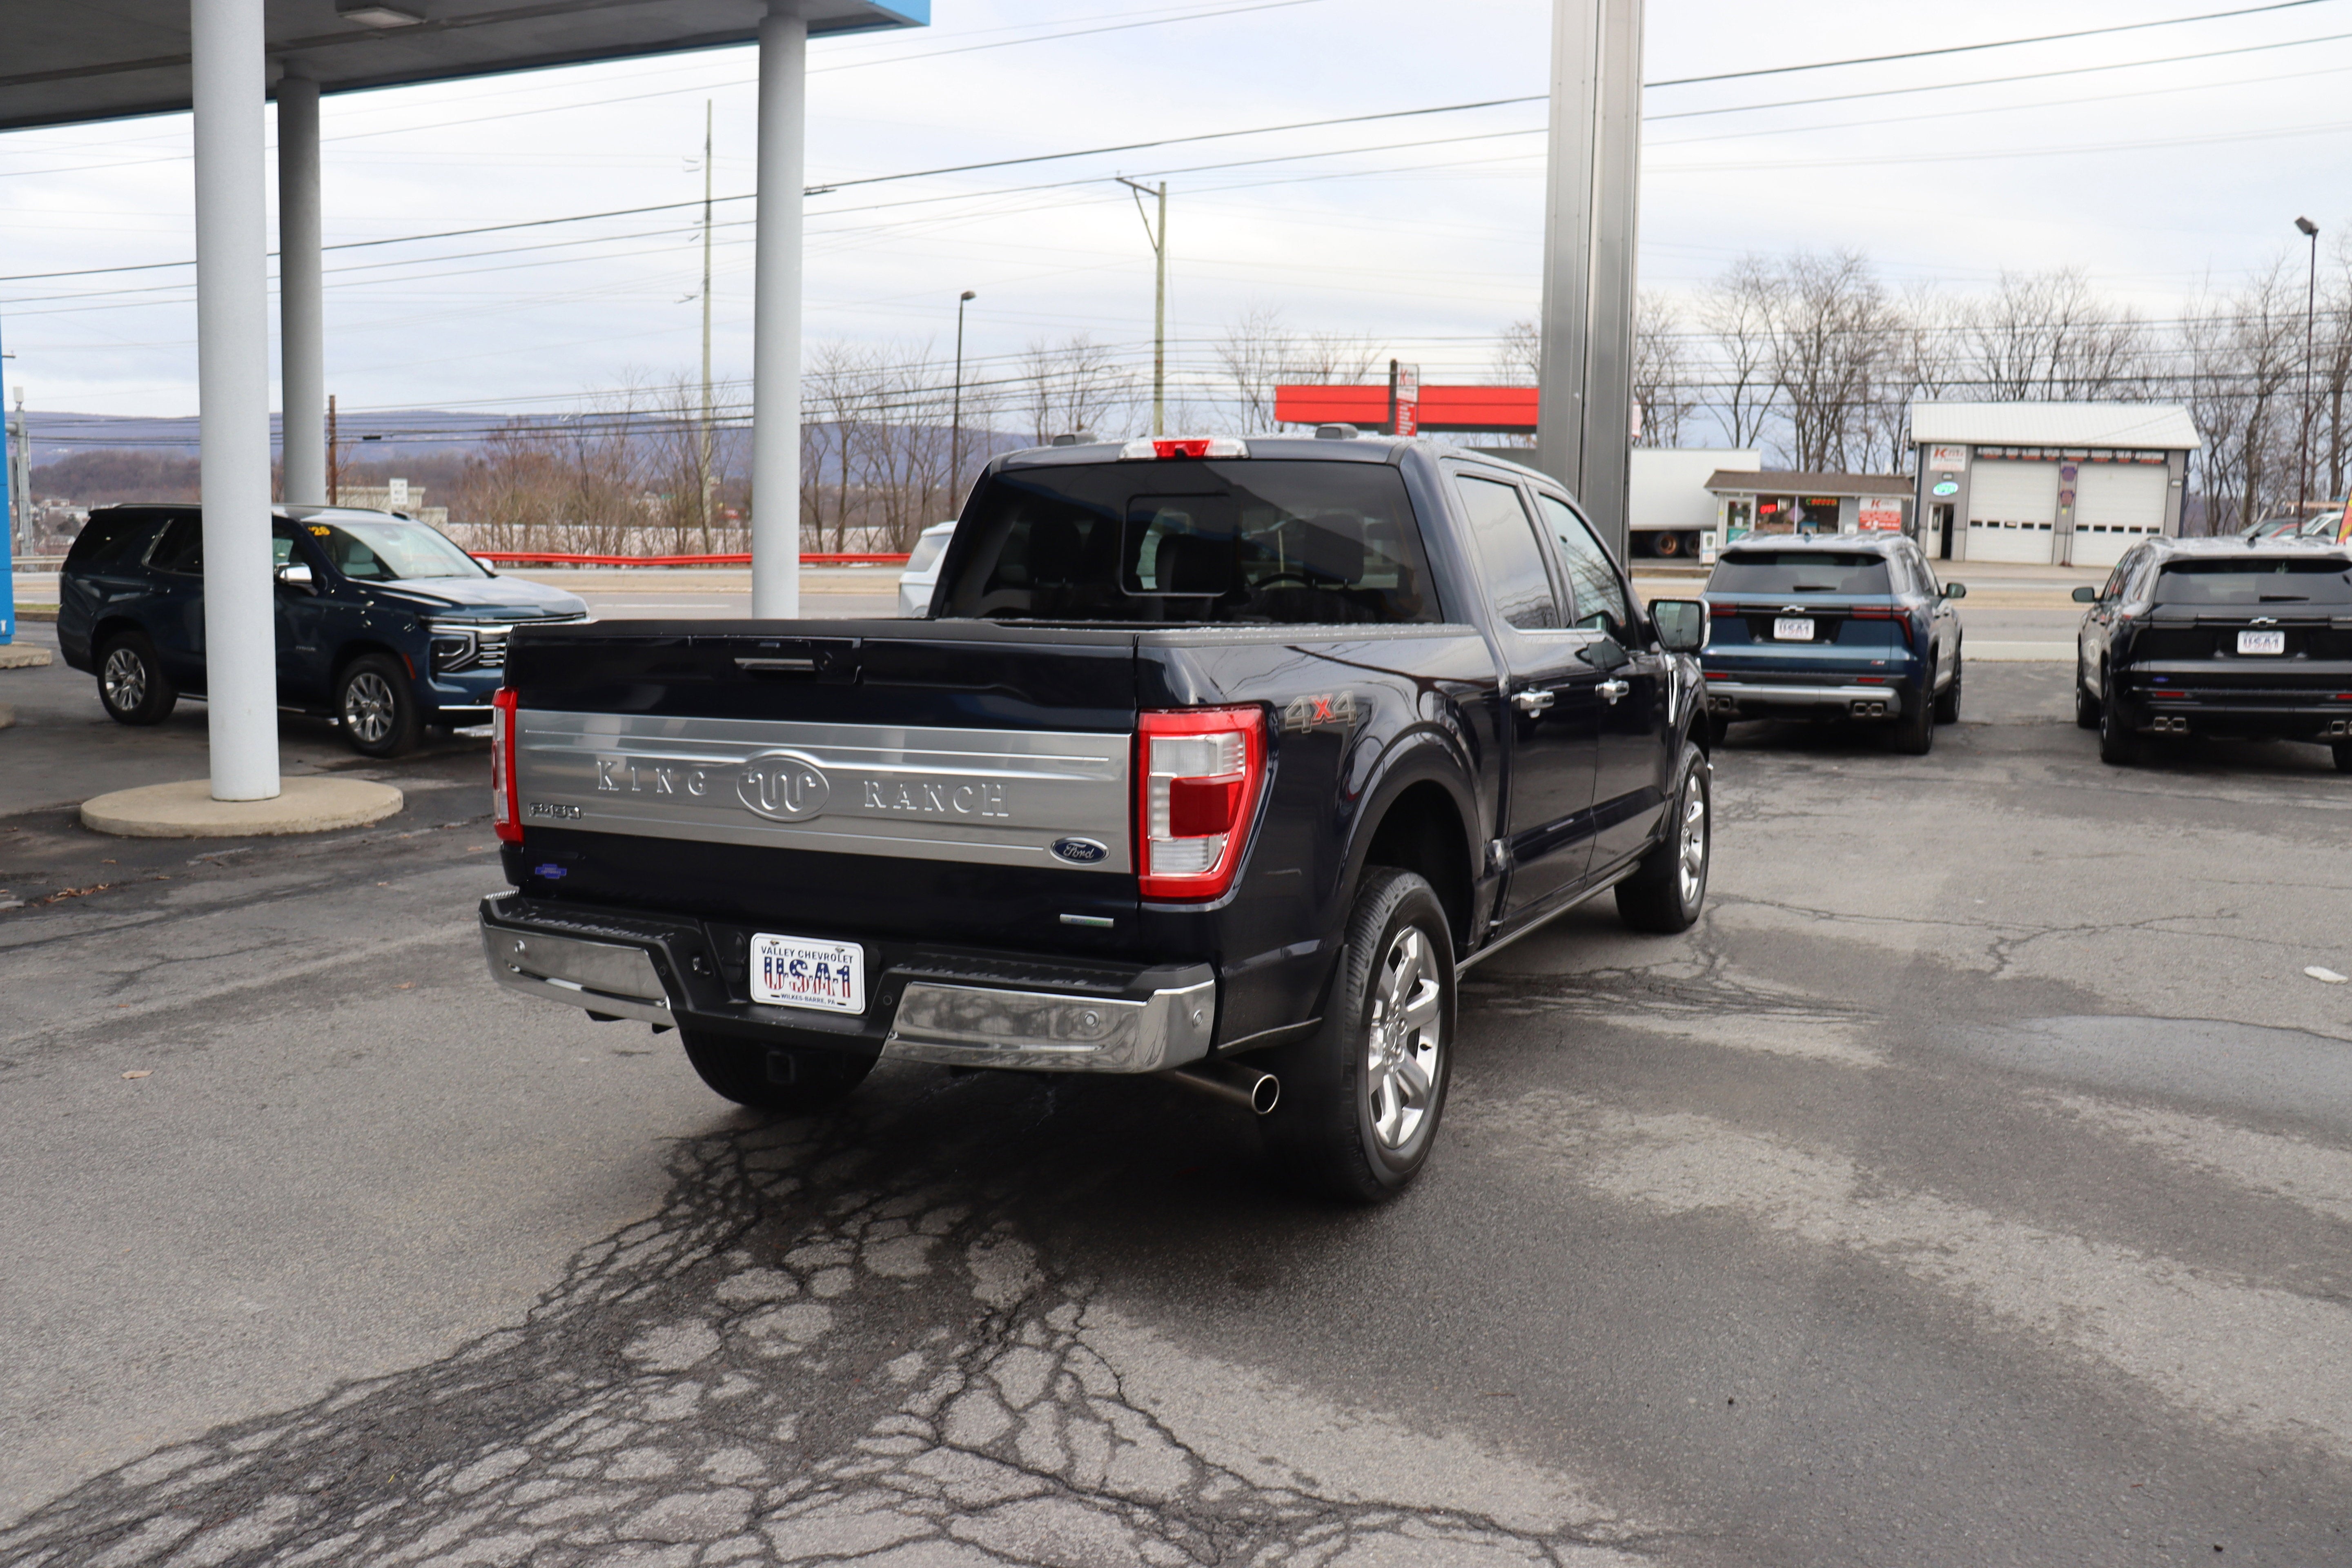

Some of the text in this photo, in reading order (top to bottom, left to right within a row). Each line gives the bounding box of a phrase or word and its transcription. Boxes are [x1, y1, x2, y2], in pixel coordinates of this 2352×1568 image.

[597, 760, 1009, 817] KING RANCH
[1063, 842, 1094, 859] Ford
[761, 946, 853, 964] VALLEY CHEVROLET
[781, 993, 826, 1005] WILKES-BARRE,
